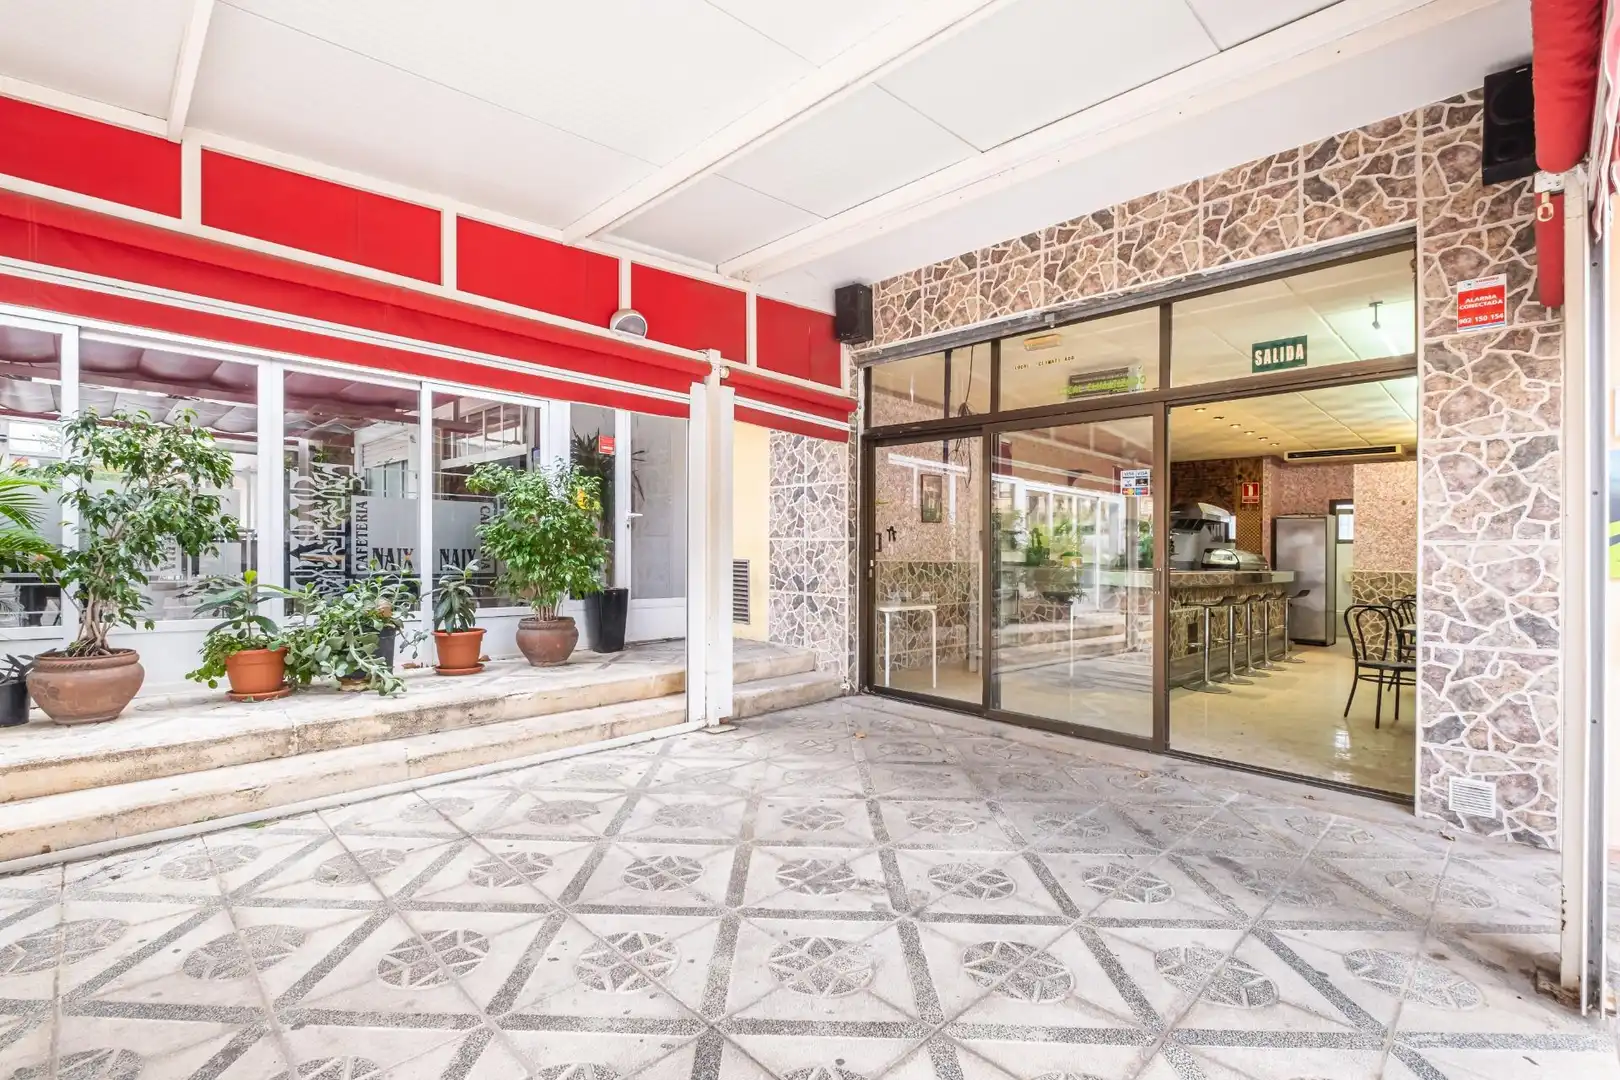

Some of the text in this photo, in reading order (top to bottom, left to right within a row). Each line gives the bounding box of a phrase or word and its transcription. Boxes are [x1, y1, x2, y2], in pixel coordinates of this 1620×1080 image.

[1459, 299, 1503, 309] CONECTADA
[1465, 295, 1497, 303] ALARMA
[1459, 317, 1472, 325] 902
[1255, 343, 1304, 366] SALIDA
[355, 501, 368, 571] CAFETERIA
[372, 547, 415, 571] NAIX
